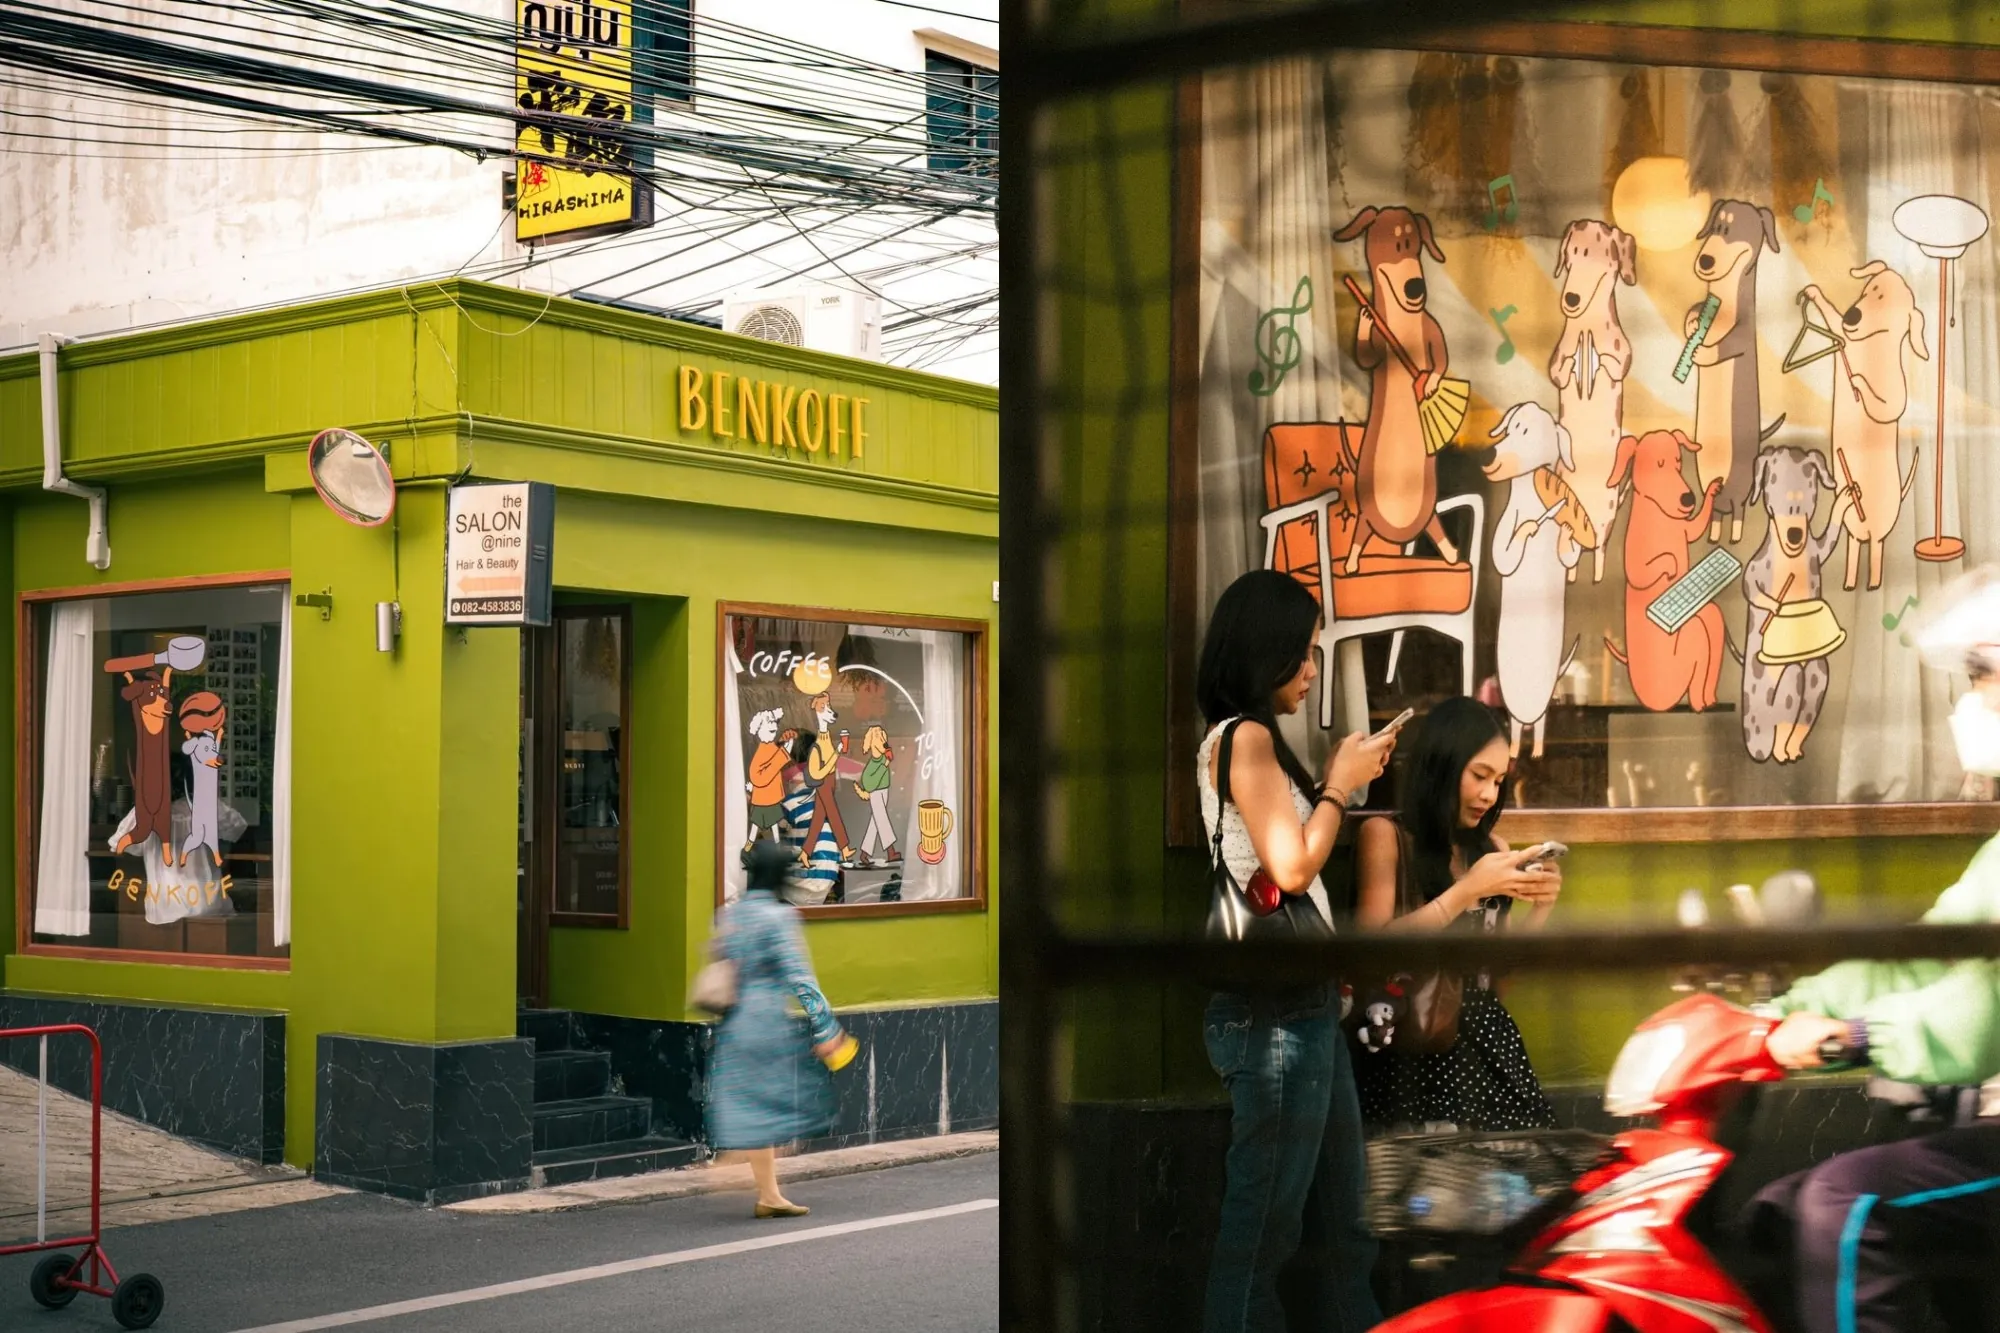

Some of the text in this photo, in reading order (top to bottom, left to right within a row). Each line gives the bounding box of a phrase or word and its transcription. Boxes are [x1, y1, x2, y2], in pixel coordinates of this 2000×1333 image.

[519, 188, 625, 219] HIRASHIMA
[820, 296, 841, 305] YORK
[679, 365, 871, 458] BENKOFF
[503, 494, 522, 509] the
[456, 510, 521, 534] SALON
[481, 534, 521, 553] @nine
[456, 558, 519, 571] Hair & Beauty
[461, 601, 521, 613] 082-4583836
[749, 650, 832, 679] COFFEE
[915, 732, 934, 756] TO
[107, 869, 234, 908] BENKOFF
